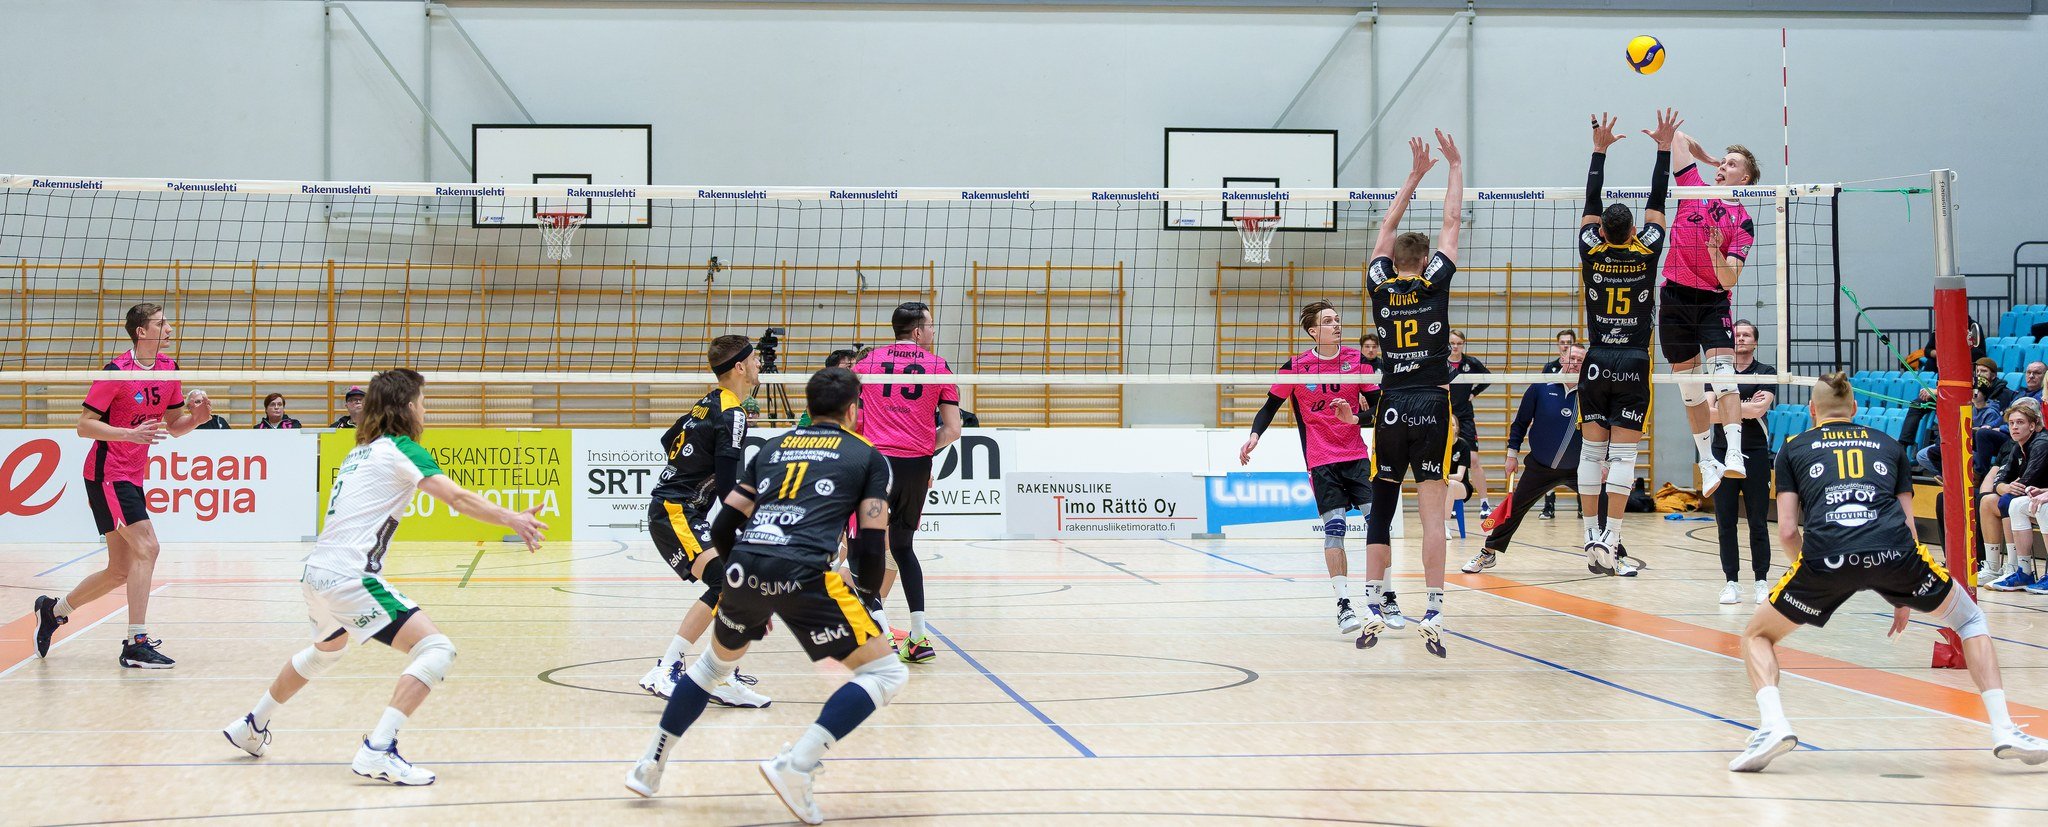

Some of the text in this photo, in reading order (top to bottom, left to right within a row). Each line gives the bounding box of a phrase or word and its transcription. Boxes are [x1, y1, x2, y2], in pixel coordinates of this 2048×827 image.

[33, 179, 102, 190] Rakennuslehti
[301, 185, 371, 195] Rakennuslehti
[435, 187, 505, 197] Rakennuslehti
[567, 188, 636, 198] Rakennuslehti
[698, 189, 767, 199] Rakennuslehti
[829, 190, 898, 200] Rakennuslehti
[961, 190, 1030, 200] Rakennuslehti
[1091, 191, 1160, 201] Rakennuslehti
[1222, 191, 1289, 201] Rakennuslehti
[1478, 190, 1545, 200] Rakennuslehti
[1592, 262, 1647, 274] RODRIGUEZ
[1605, 287, 1632, 315] 15
[1595, 314, 1639, 325] WETTERI
[1393, 319, 1419, 349] 12
[1386, 350, 1429, 360] WETTERI
[143, 386, 161, 407] 15
[780, 435, 843, 450] SHURDHI
[142, 451, 267, 480] ntaan
[1832, 448, 1865, 480] 10
[588, 468, 651, 495] SRT
[777, 461, 810, 500] 11
[1017, 483, 1112, 494] RAKENNUSLIIKE
[1213, 480, 1313, 502] Lumo
[1825, 490, 1876, 505] SRT OY
[144, 487, 256, 522] ergia
[752, 512, 805, 526] SRT OY
[1053, 496, 1177, 531] Timo Rättö Oy
[1828, 511, 1874, 520] TUOVINEN
[1065, 522, 1176, 532] rakennusliiketimoratto.fi
[745, 531, 788, 544] TUOVINEN
[1783, 591, 1822, 617] RAMIRENT
[809, 623, 850, 645] islvi
